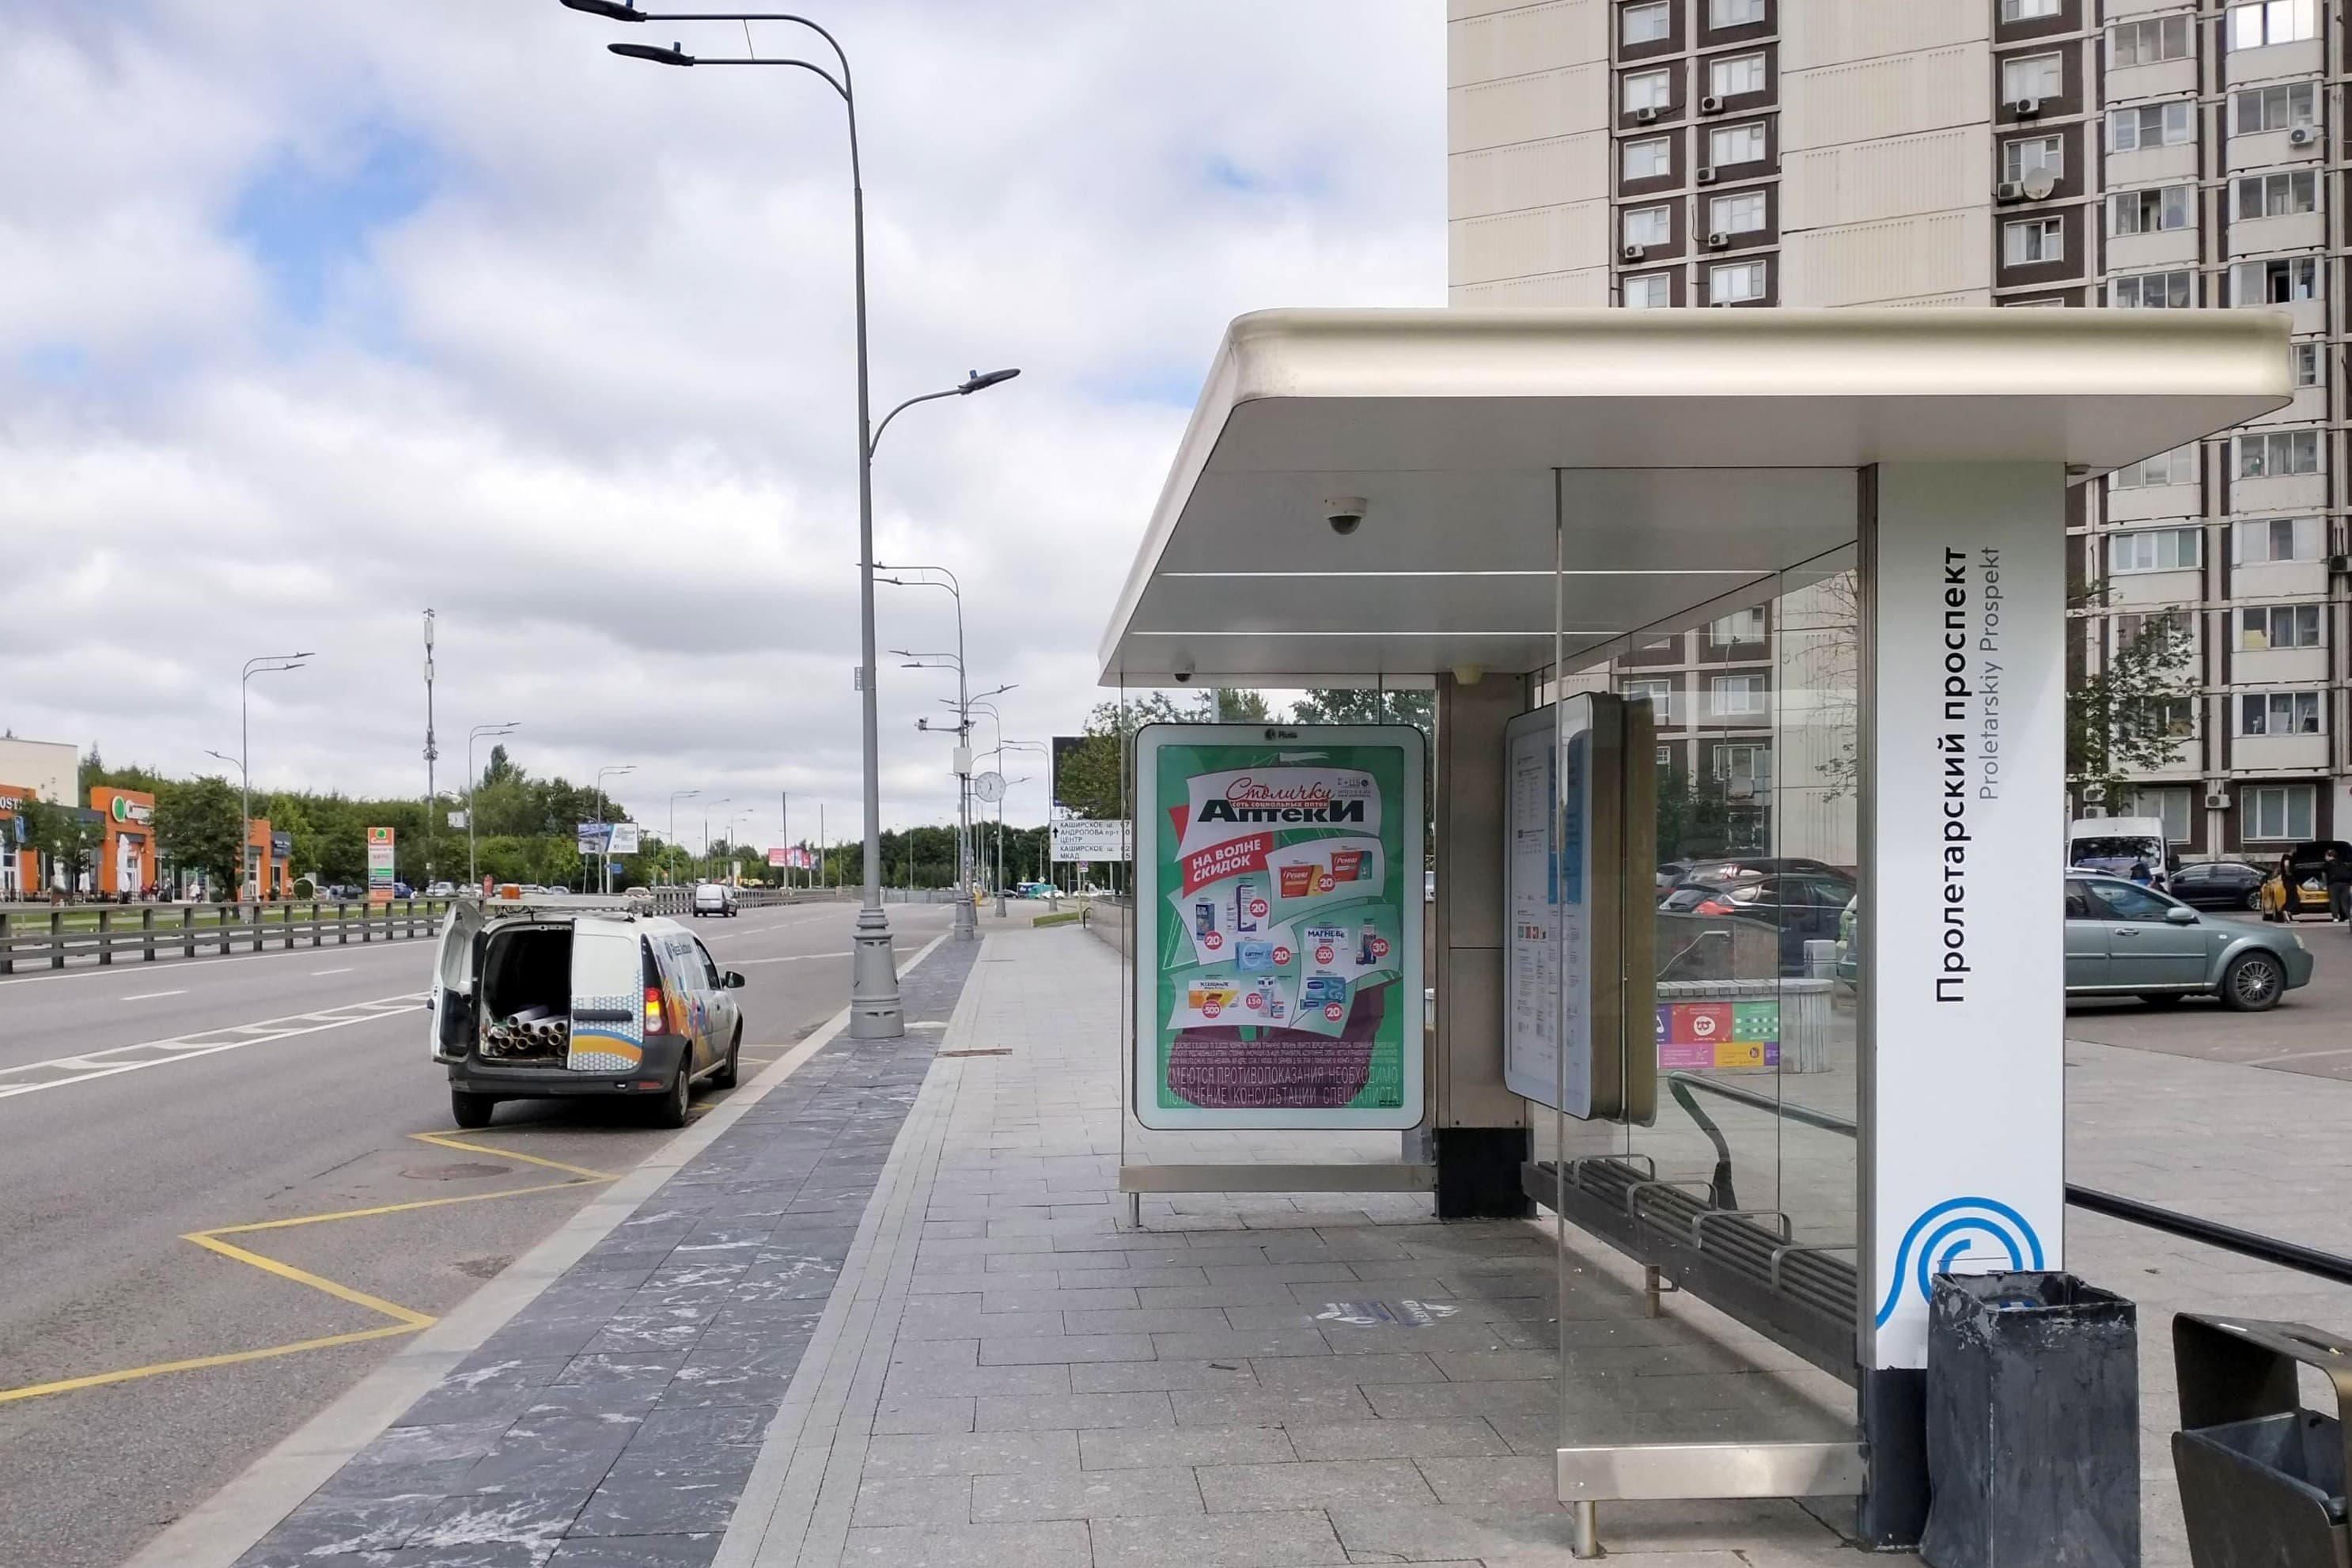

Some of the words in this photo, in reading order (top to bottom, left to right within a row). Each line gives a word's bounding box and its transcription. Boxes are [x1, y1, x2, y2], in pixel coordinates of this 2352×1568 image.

[1979, 547, 2003, 651] Prospekt
[1945, 547, 1972, 719] проспект
[1979, 661, 2003, 799] Proletarskiy
[1226, 777, 1335, 800] Столички
[1192, 854, 1212, 869] НА
[1215, 839, 1261, 861] ВОЛНЕ
[1193, 854, 1251, 882] СКИДОК
[1936, 734, 1972, 1002] Пролетарский
[1165, 1066, 1214, 1084] ИМЕЮТСЯ
[1218, 1066, 1324, 1084] ПРОТИВОПОКАЗАНИЯ
[1329, 1066, 1398, 1084] НЕОБХОДИМО
[1165, 1087, 1227, 1104] ПОЛУЧЕНИЕ
[1233, 1087, 1316, 1106] КОНСУЛЬТАЦИИ
[1323, 1086, 1399, 1106] СПЕЦИАЛИСТА
